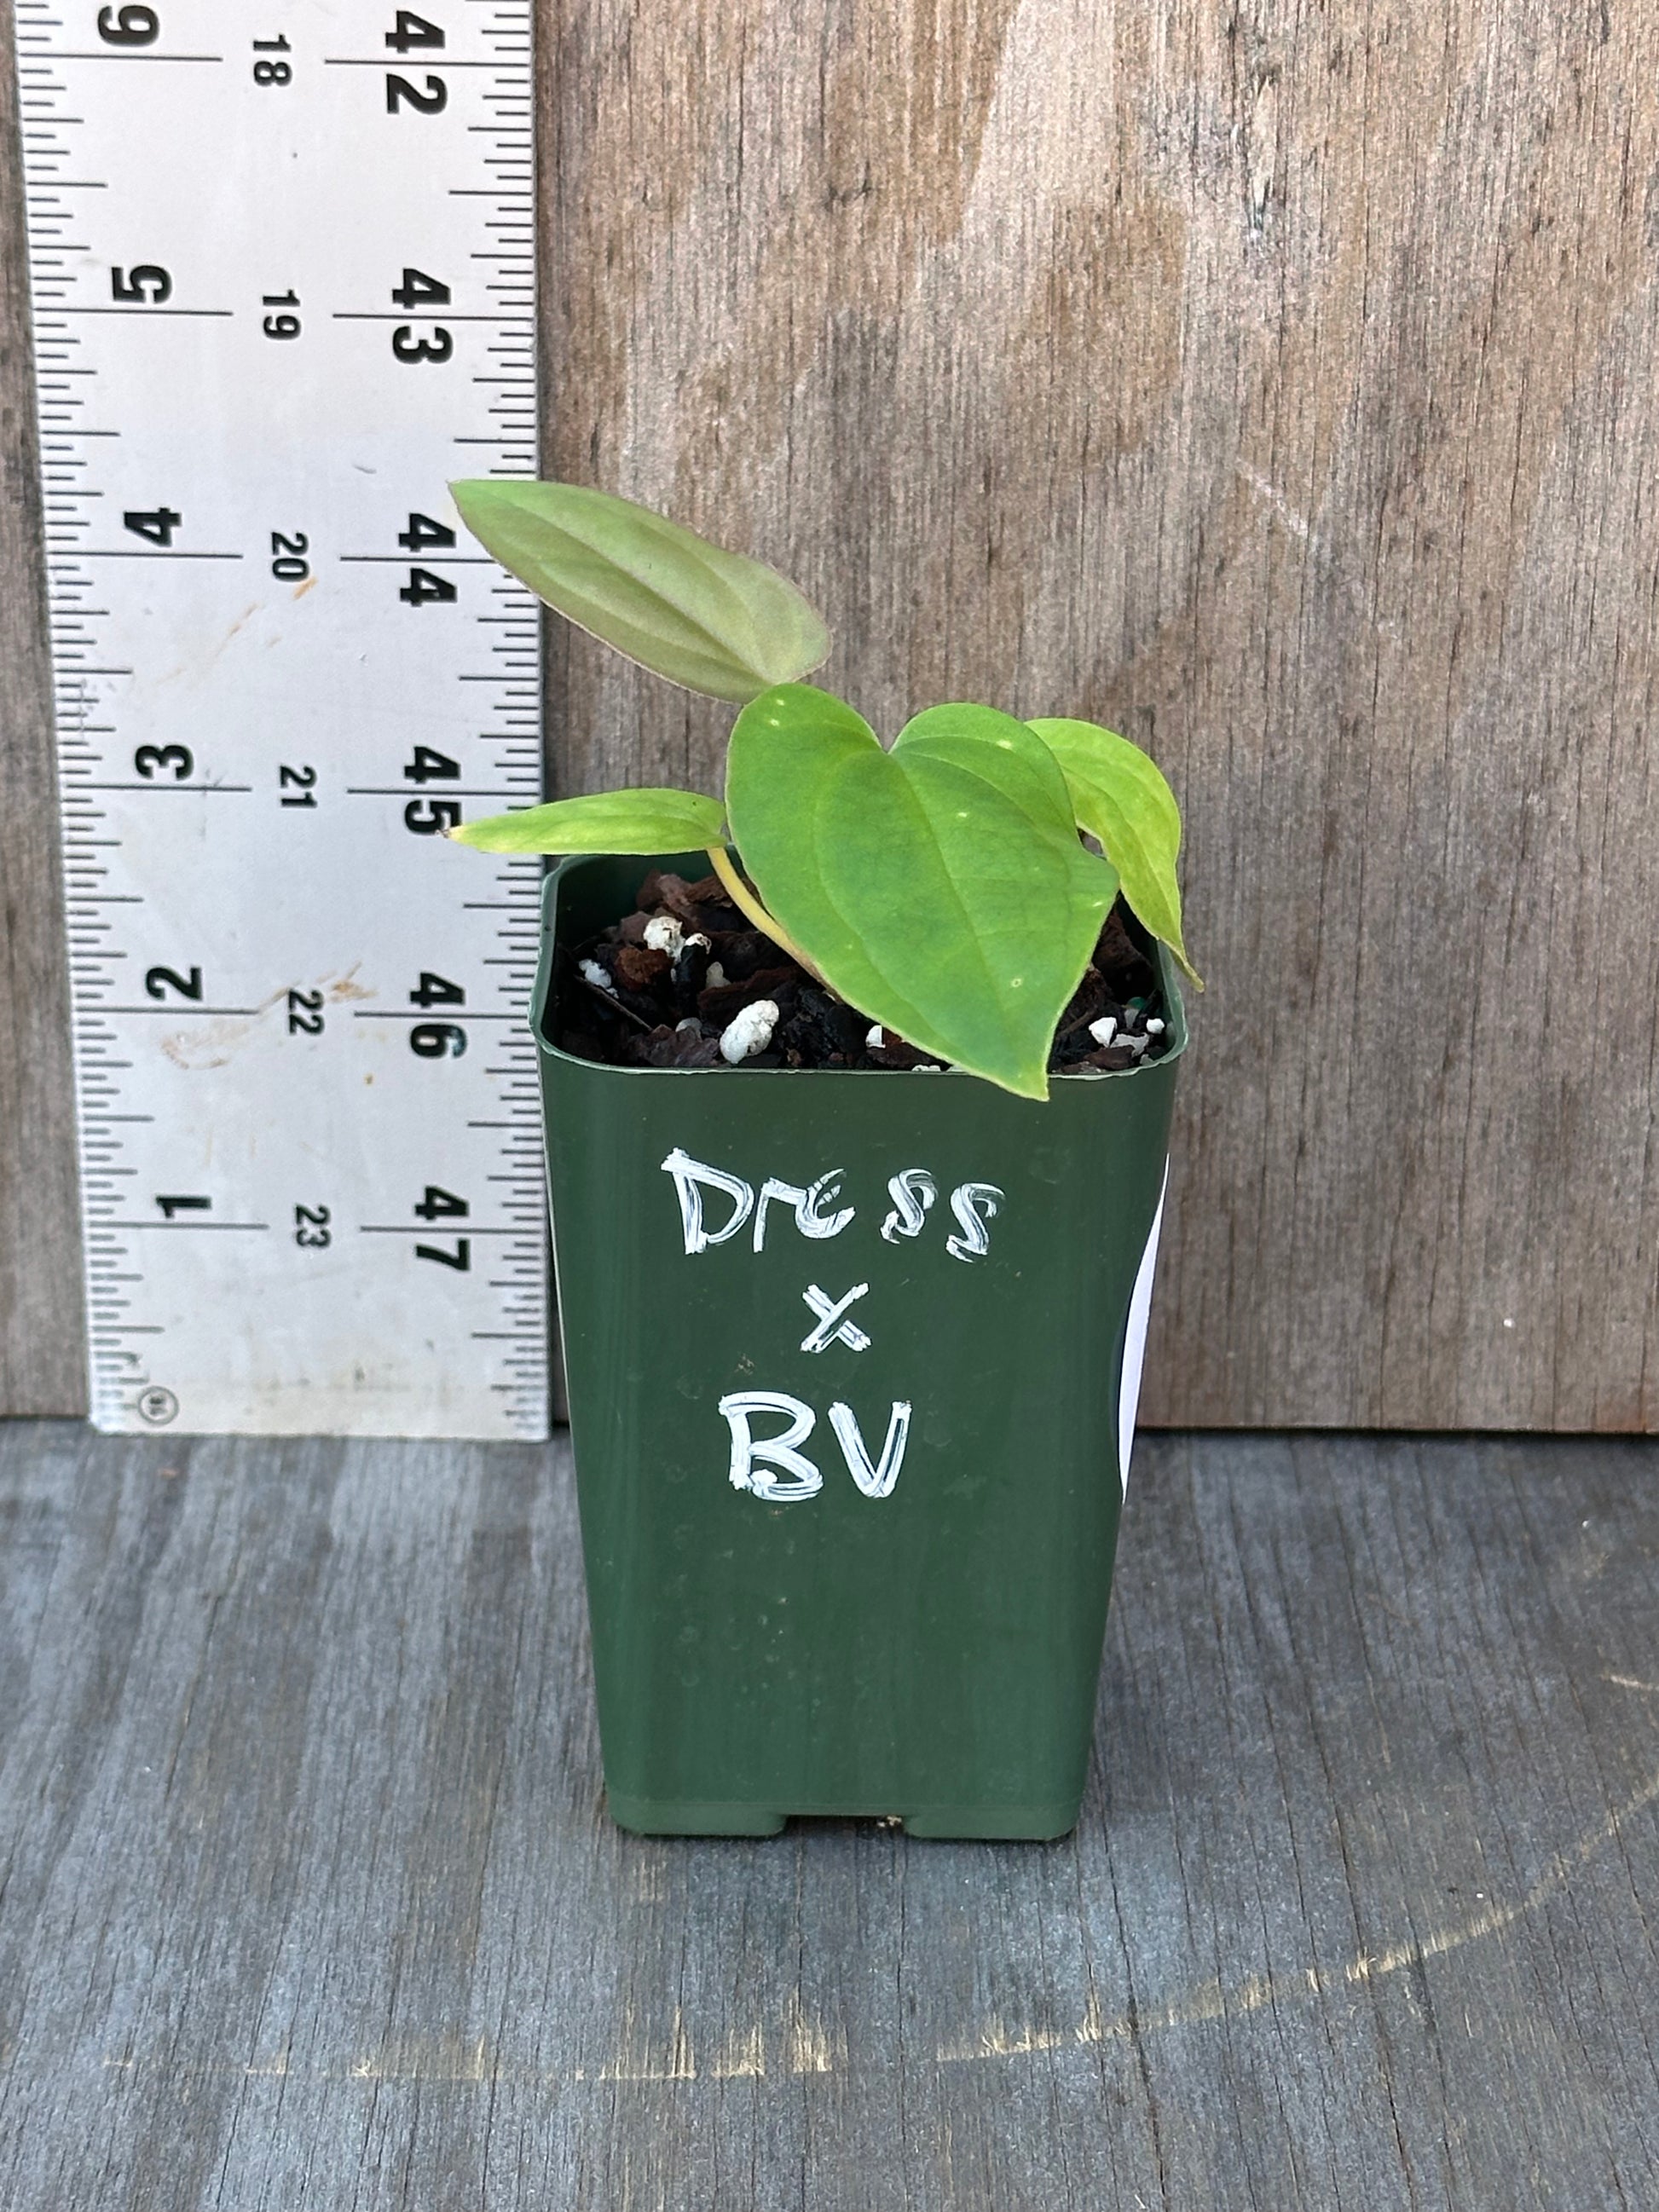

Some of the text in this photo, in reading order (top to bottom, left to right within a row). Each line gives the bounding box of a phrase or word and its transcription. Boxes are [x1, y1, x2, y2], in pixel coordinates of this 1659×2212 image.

[96, 3, 160, 47] 6
[252, 33, 292, 87] 18
[384, 9, 448, 116] 42
[110, 263, 173, 305] 5
[261, 288, 302, 341] 19
[390, 267, 454, 366] 43
[122, 506, 182, 548] 4
[270, 530, 310, 583] 20
[397, 511, 459, 609] 44
[133, 743, 194, 781] 3
[279, 765, 318, 809] 21
[402, 745, 463, 837] 45
[144, 966, 204, 1002] 2
[286, 988, 326, 1036] 22
[408, 971, 469, 1060] 46
[154, 1195, 212, 1220] 1
[294, 1204, 332, 1250] 23
[413, 1185, 473, 1273] 47
[660, 1146, 1004, 1263] Dress
[718, 1390, 912, 1502] BV
